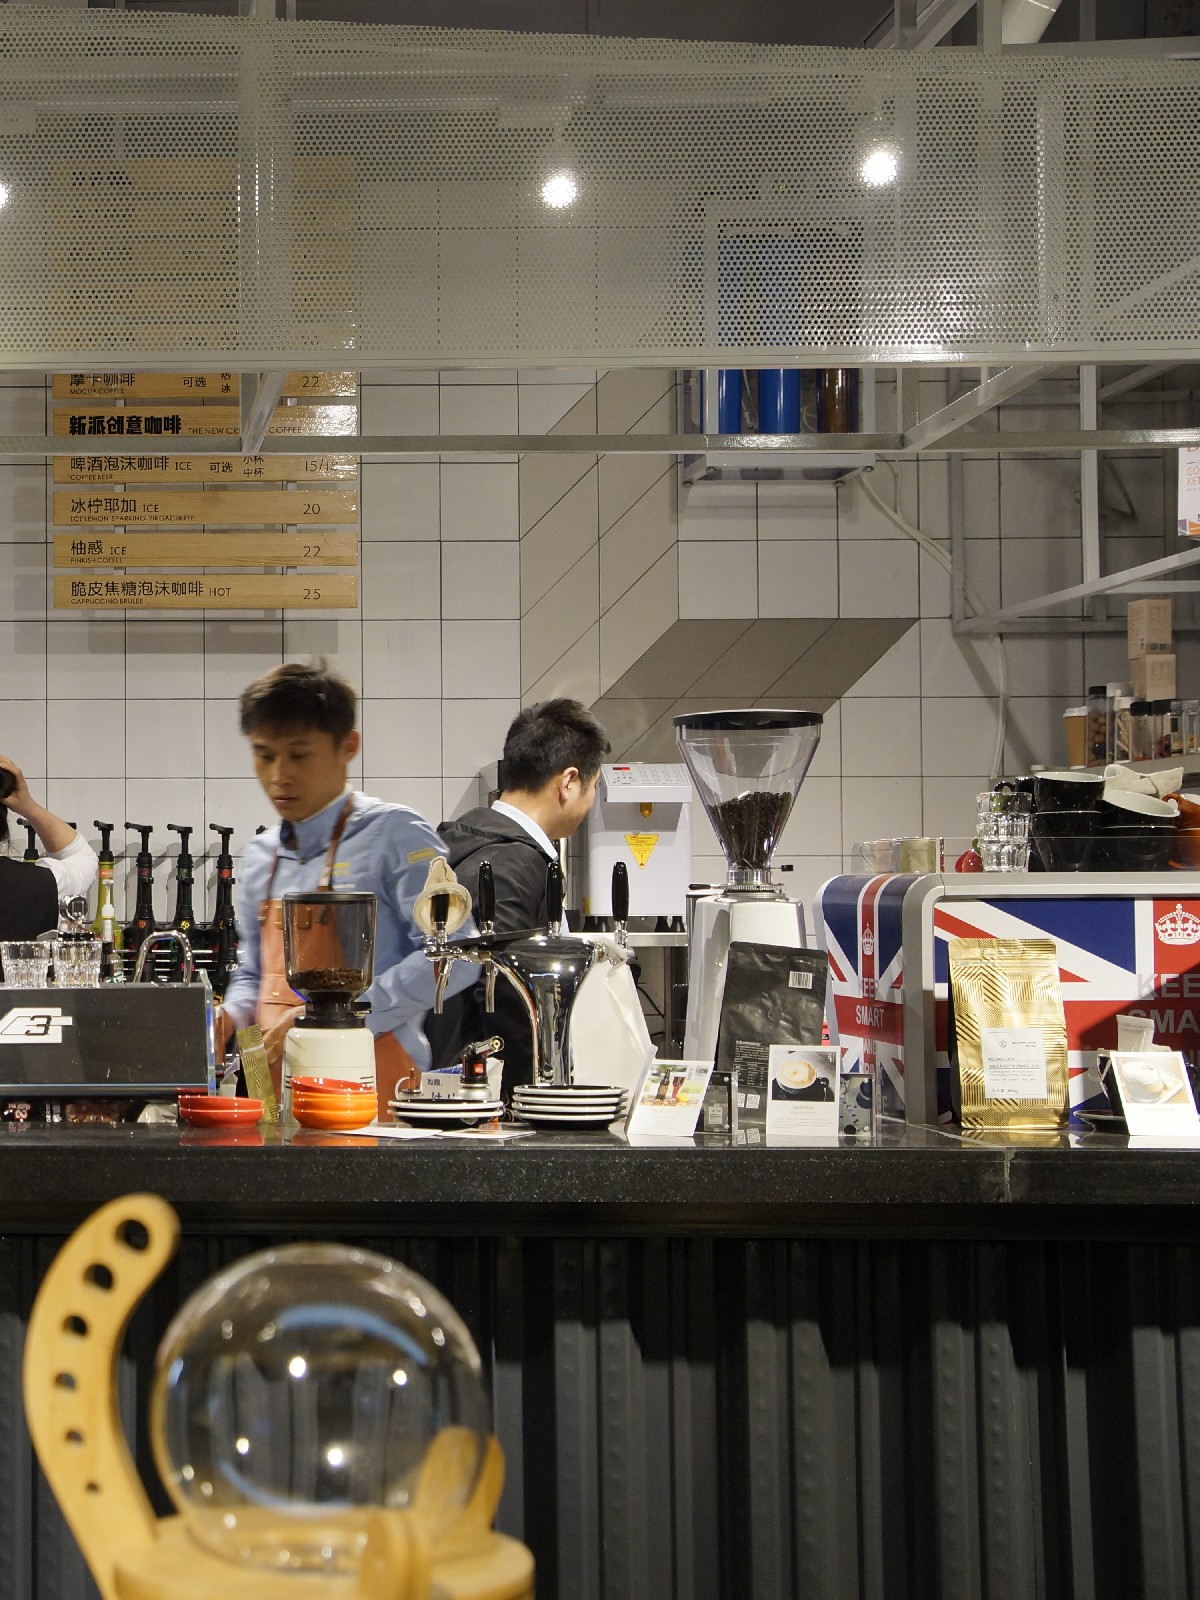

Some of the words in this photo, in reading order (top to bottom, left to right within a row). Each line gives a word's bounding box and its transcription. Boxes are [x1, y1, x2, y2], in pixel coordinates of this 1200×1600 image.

[69, 373, 136, 387] 摩卡咖啡
[182, 376, 207, 388] 可选
[302, 376, 319, 389] 22
[221, 384, 231, 393] 冰
[69, 415, 182, 435] 新派创意咖啡
[188, 427, 203, 435] THE
[204, 427, 224, 435] NEW
[268, 426, 302, 434] COFFEE
[70, 456, 170, 472] 啤酒泡沫咖啡
[175, 462, 192, 470] ICE
[209, 462, 233, 473] 可选
[243, 467, 265, 478] 中杯
[71, 498, 137, 513] 冰柠耶加
[142, 504, 160, 512] ICE
[303, 503, 321, 515] 20
[71, 540, 104, 555] 柚惑
[110, 547, 127, 555] ICE
[303, 546, 321, 557] 22
[71, 581, 204, 597] 脆皮焦糖泡沫咖啡
[209, 588, 231, 596] HOT
[303, 588, 321, 600] 25
[855, 1004, 885, 1029] SMART
